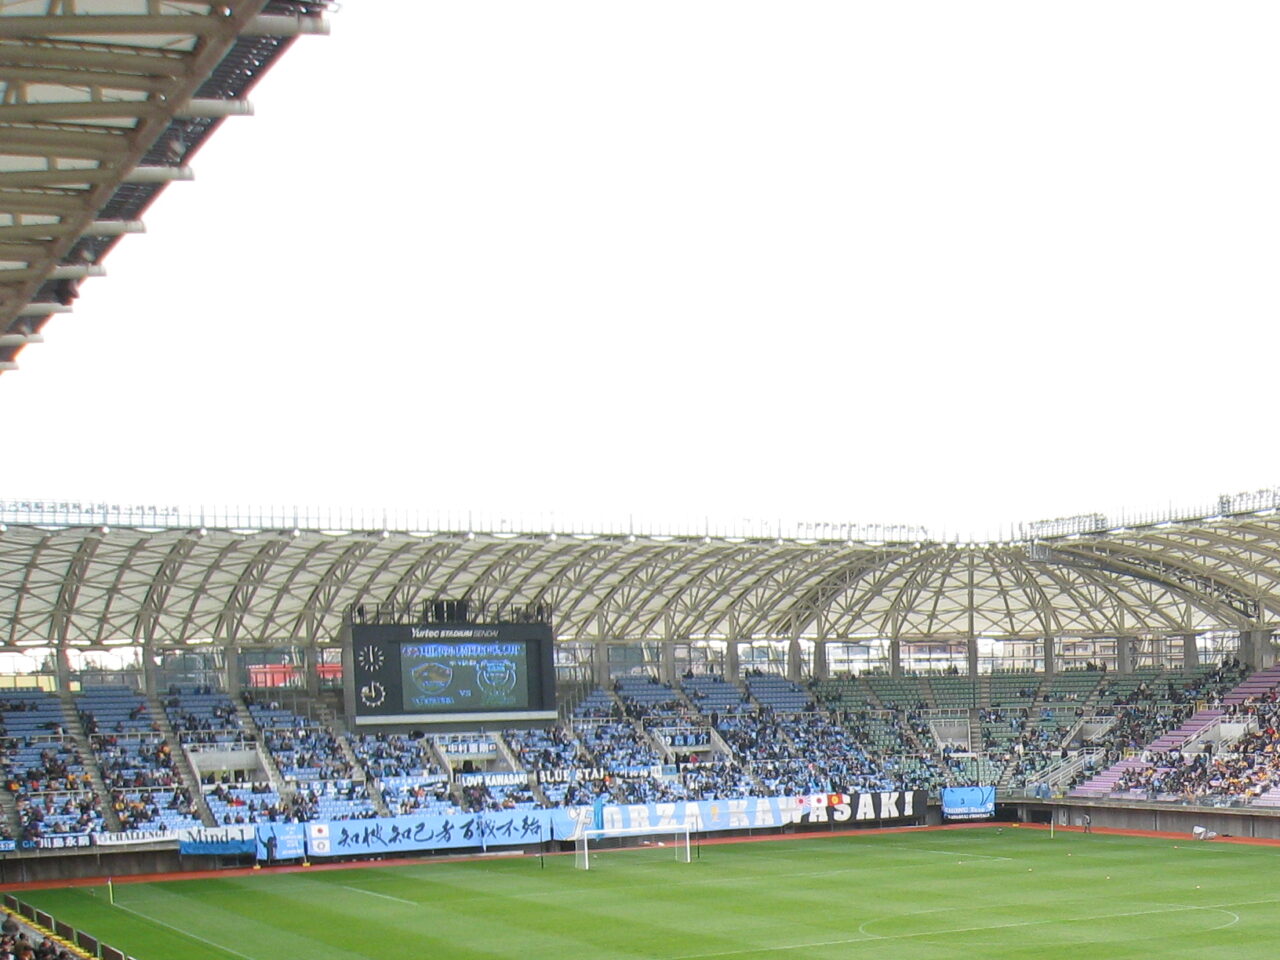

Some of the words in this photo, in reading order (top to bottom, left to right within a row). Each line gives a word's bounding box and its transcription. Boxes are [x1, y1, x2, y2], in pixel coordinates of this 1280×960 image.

[411, 627, 439, 639] Yurtec
[440, 629, 473, 638] STADIUM
[473, 629, 499, 638] SENDAI
[462, 775, 483, 787] LOVE
[484, 773, 528, 786] KAWASAKI
[539, 769, 569, 783] BLUE
[567, 802, 704, 841] FORZA
[728, 790, 914, 828] KAWASAKI
[188, 828, 246, 845] Mind-1
